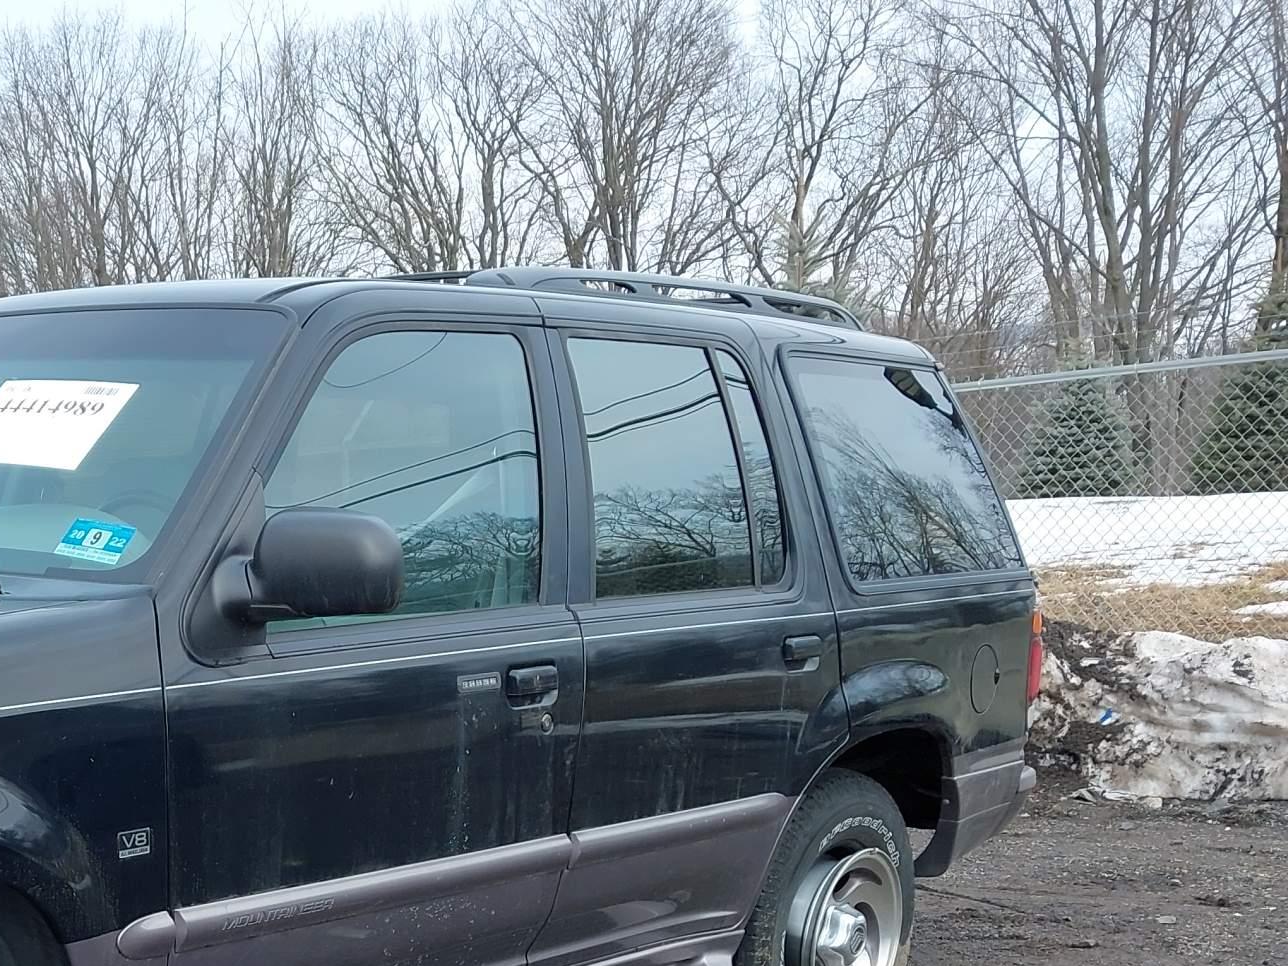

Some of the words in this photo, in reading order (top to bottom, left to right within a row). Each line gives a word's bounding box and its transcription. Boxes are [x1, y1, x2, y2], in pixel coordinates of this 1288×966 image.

[70, 529, 86, 540] 20
[89, 531, 103, 546] 9
[108, 536, 127, 548] 22
[122, 832, 147, 849] V8
